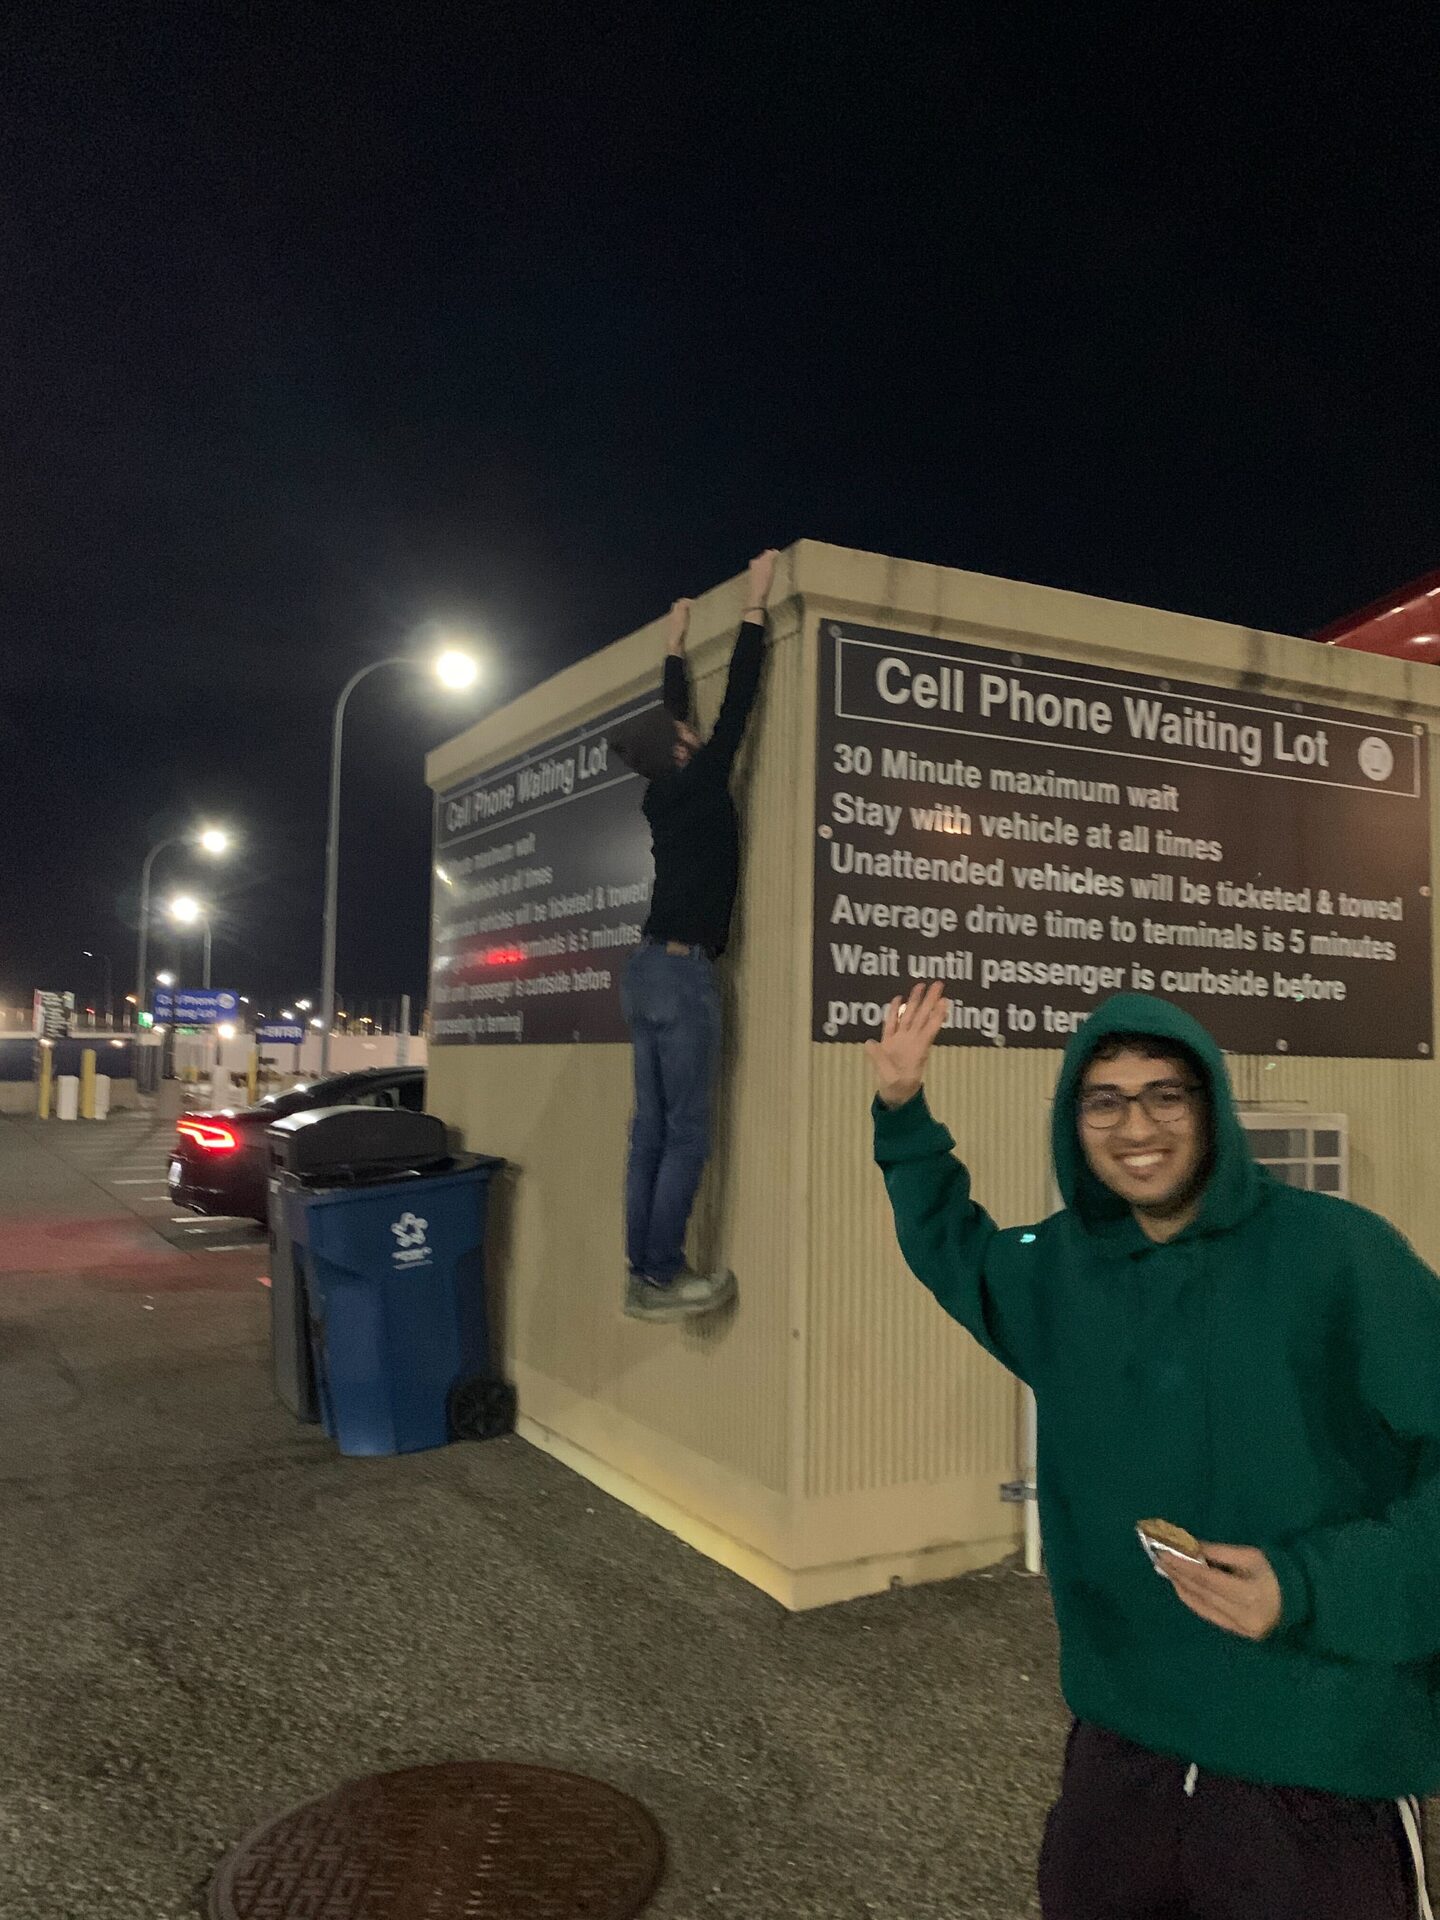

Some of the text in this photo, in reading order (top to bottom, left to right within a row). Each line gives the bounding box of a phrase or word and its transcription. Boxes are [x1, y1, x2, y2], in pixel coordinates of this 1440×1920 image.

[875, 657, 1330, 767] Cell Phone Waiting Lot
[516, 758, 576, 804] Waiting
[578, 737, 608, 780] Lot
[833, 743, 1180, 813] 30 Minute maximum wait
[832, 791, 1224, 863] Stay with vehicle at all times
[830, 841, 1404, 921] Unattended vehicles will be ticketed & towed
[829, 893, 1397, 962] Average drive time to terminals is 5 minutes
[829, 942, 1348, 1002] Wait until passenger is curbside before
[1005, 1003, 1038, 1032] to
